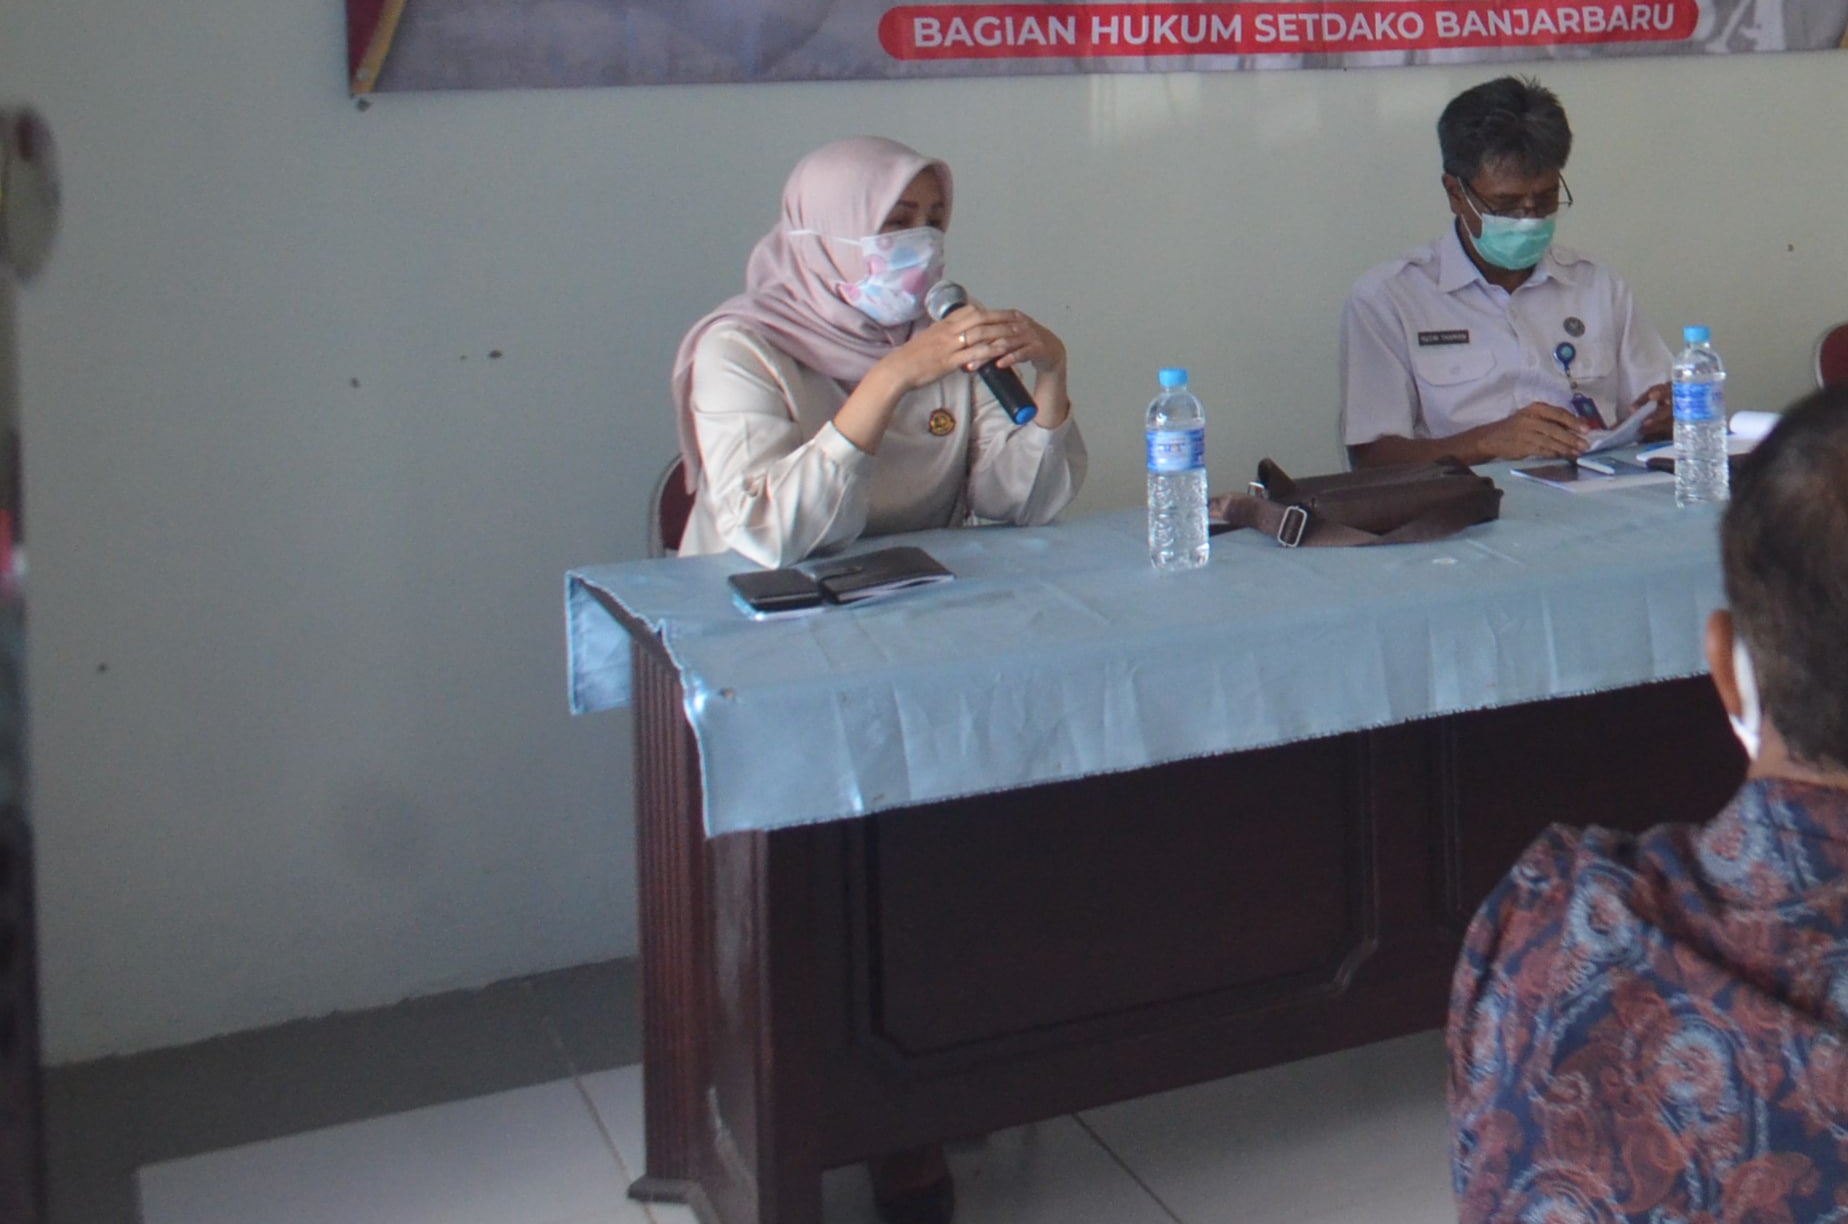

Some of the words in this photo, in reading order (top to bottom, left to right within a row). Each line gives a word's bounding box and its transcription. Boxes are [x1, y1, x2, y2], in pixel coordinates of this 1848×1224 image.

[914, 16, 1075, 47] BAGIAN
[1092, 14, 1242, 45] HUKUM
[1255, 10, 1424, 44] SETDAKO
[1436, 3, 1675, 39] BANJARBARU
